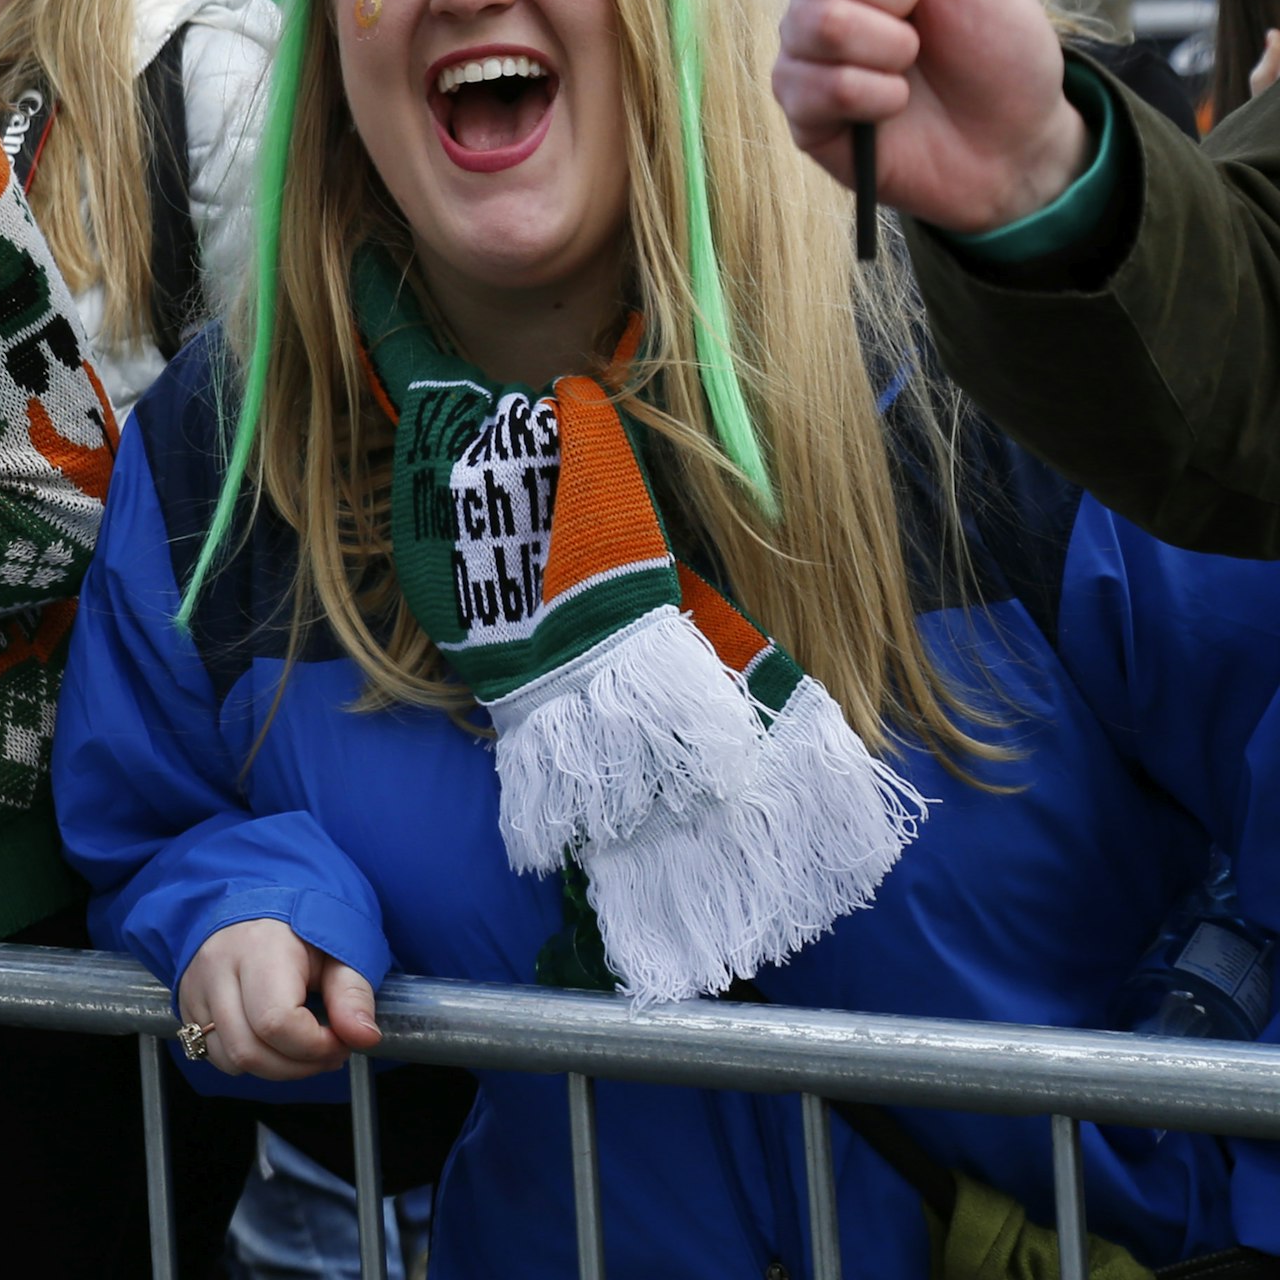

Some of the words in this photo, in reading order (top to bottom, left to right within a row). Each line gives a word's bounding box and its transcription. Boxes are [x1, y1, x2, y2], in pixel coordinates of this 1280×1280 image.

[2, 88, 44, 169] Can
[412, 467, 516, 542] March
[452, 541, 544, 630] Dubli
